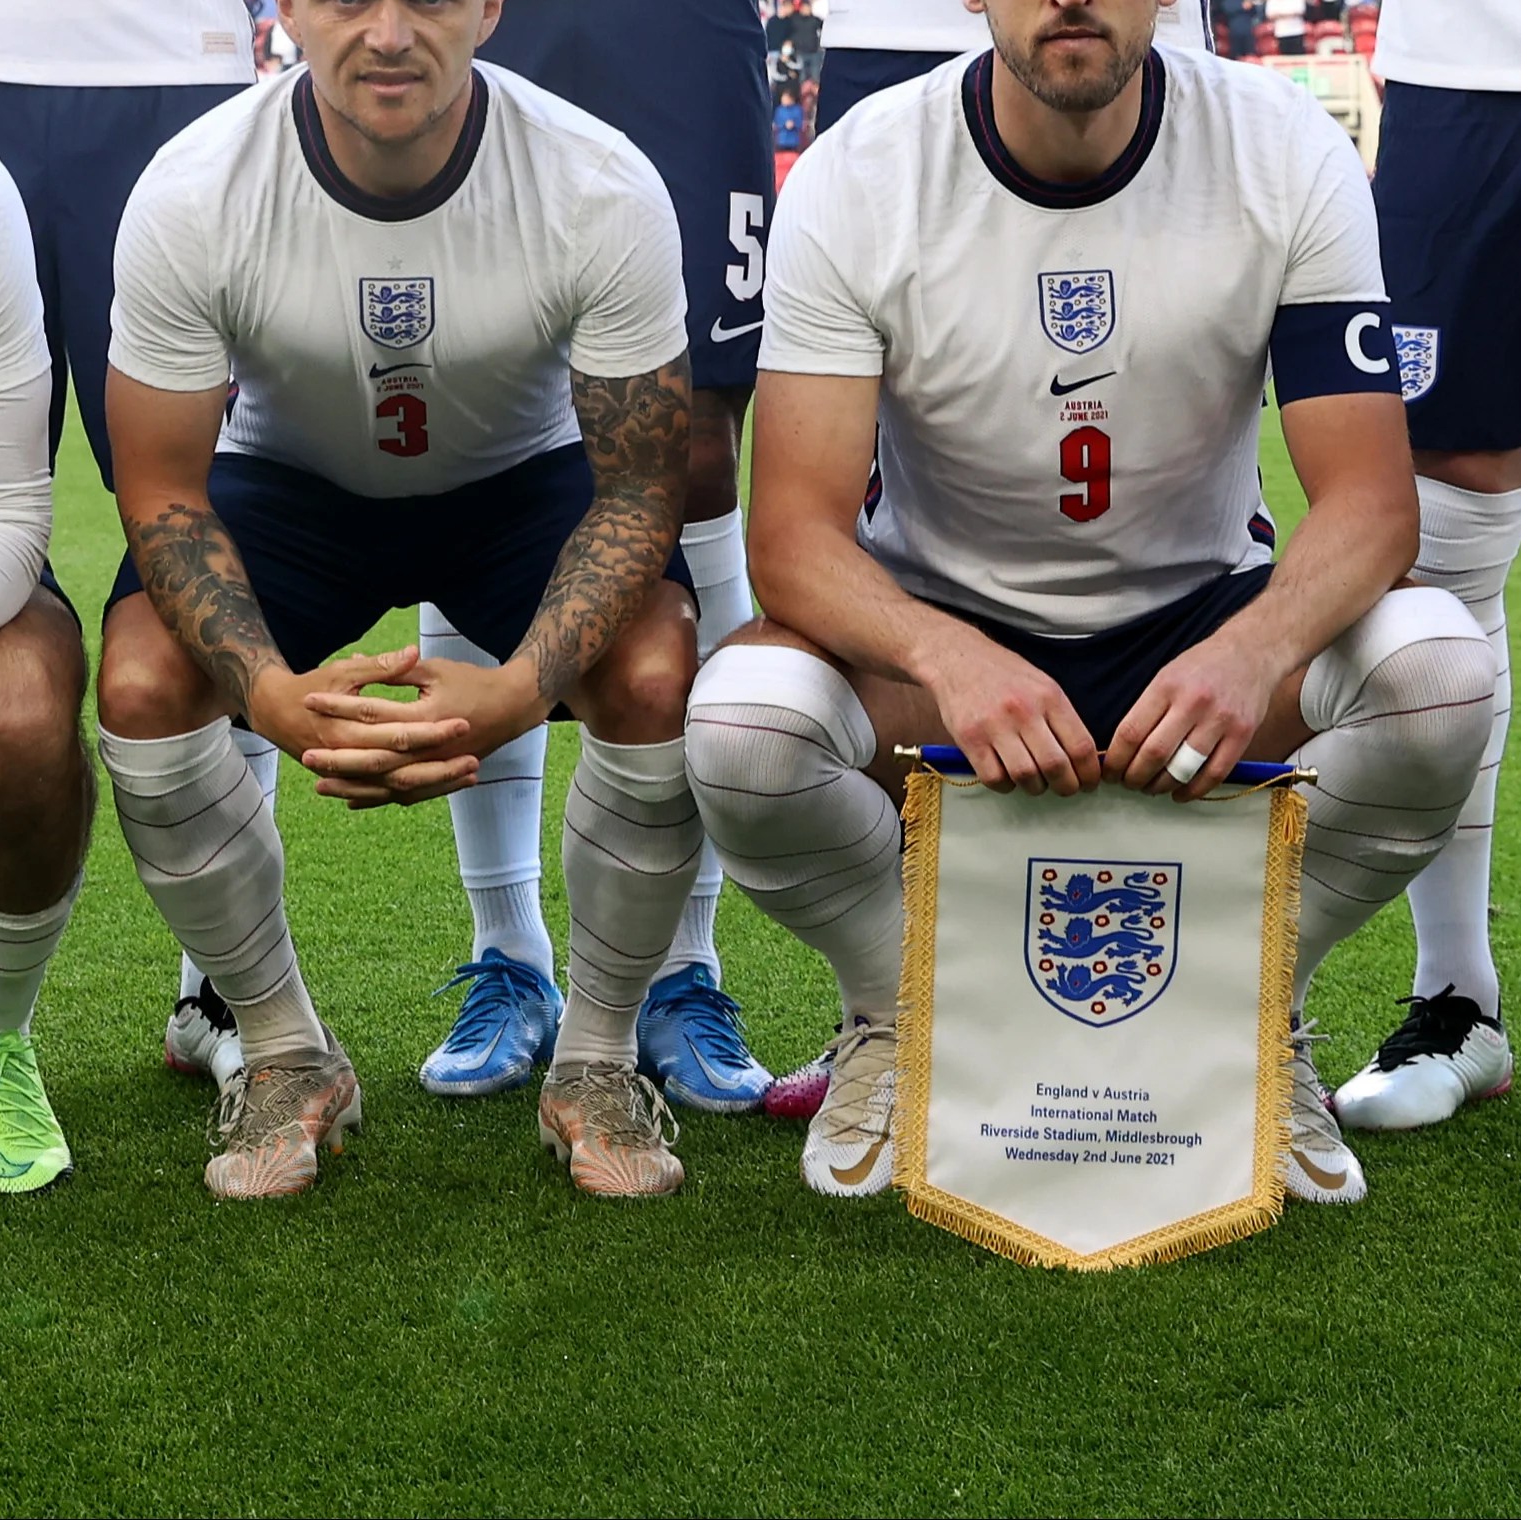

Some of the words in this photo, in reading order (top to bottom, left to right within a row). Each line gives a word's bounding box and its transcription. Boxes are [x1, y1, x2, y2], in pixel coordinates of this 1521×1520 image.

[725, 191, 764, 302] 5
[1345, 311, 1391, 375] C
[1065, 400, 1103, 410] AUSTRIA
[1067, 411, 1089, 421] JUNE
[1091, 410, 1109, 420] 2021
[376, 393, 429, 458] 3
[1059, 425, 1111, 522] 9
[1036, 1083, 1088, 1100] England
[1092, 1089, 1100, 1099] v
[1103, 1087, 1150, 1102] Austria
[1030, 1105, 1114, 1122] International
[1117, 1109, 1158, 1124] Match
[980, 1124, 1039, 1140] Riverside
[1043, 1127, 1102, 1143] Stadium,
[1105, 1130, 1203, 1148] Middlesbrough
[1005, 1147, 1079, 1164] Wednesday
[1082, 1150, 1107, 1163] 2nd
[1110, 1151, 1142, 1165] June
[1145, 1152, 1176, 1166] 2021
